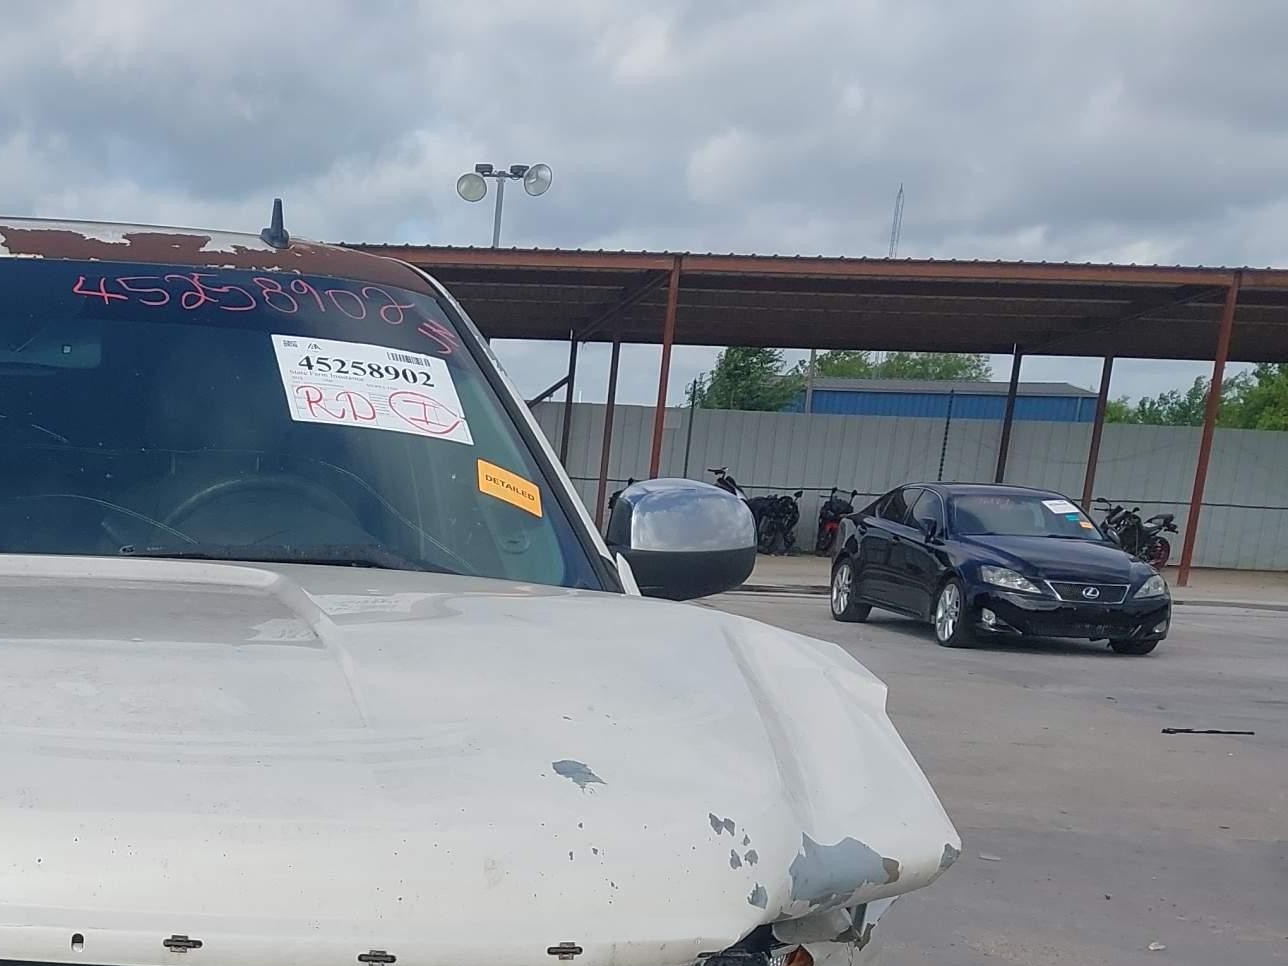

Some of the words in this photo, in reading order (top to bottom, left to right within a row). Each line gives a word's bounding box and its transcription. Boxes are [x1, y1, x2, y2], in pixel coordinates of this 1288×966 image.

[73, 274, 415, 325] 45258902
[298, 355, 435, 387] 45258902
[485, 474, 535, 501] DETAILED
